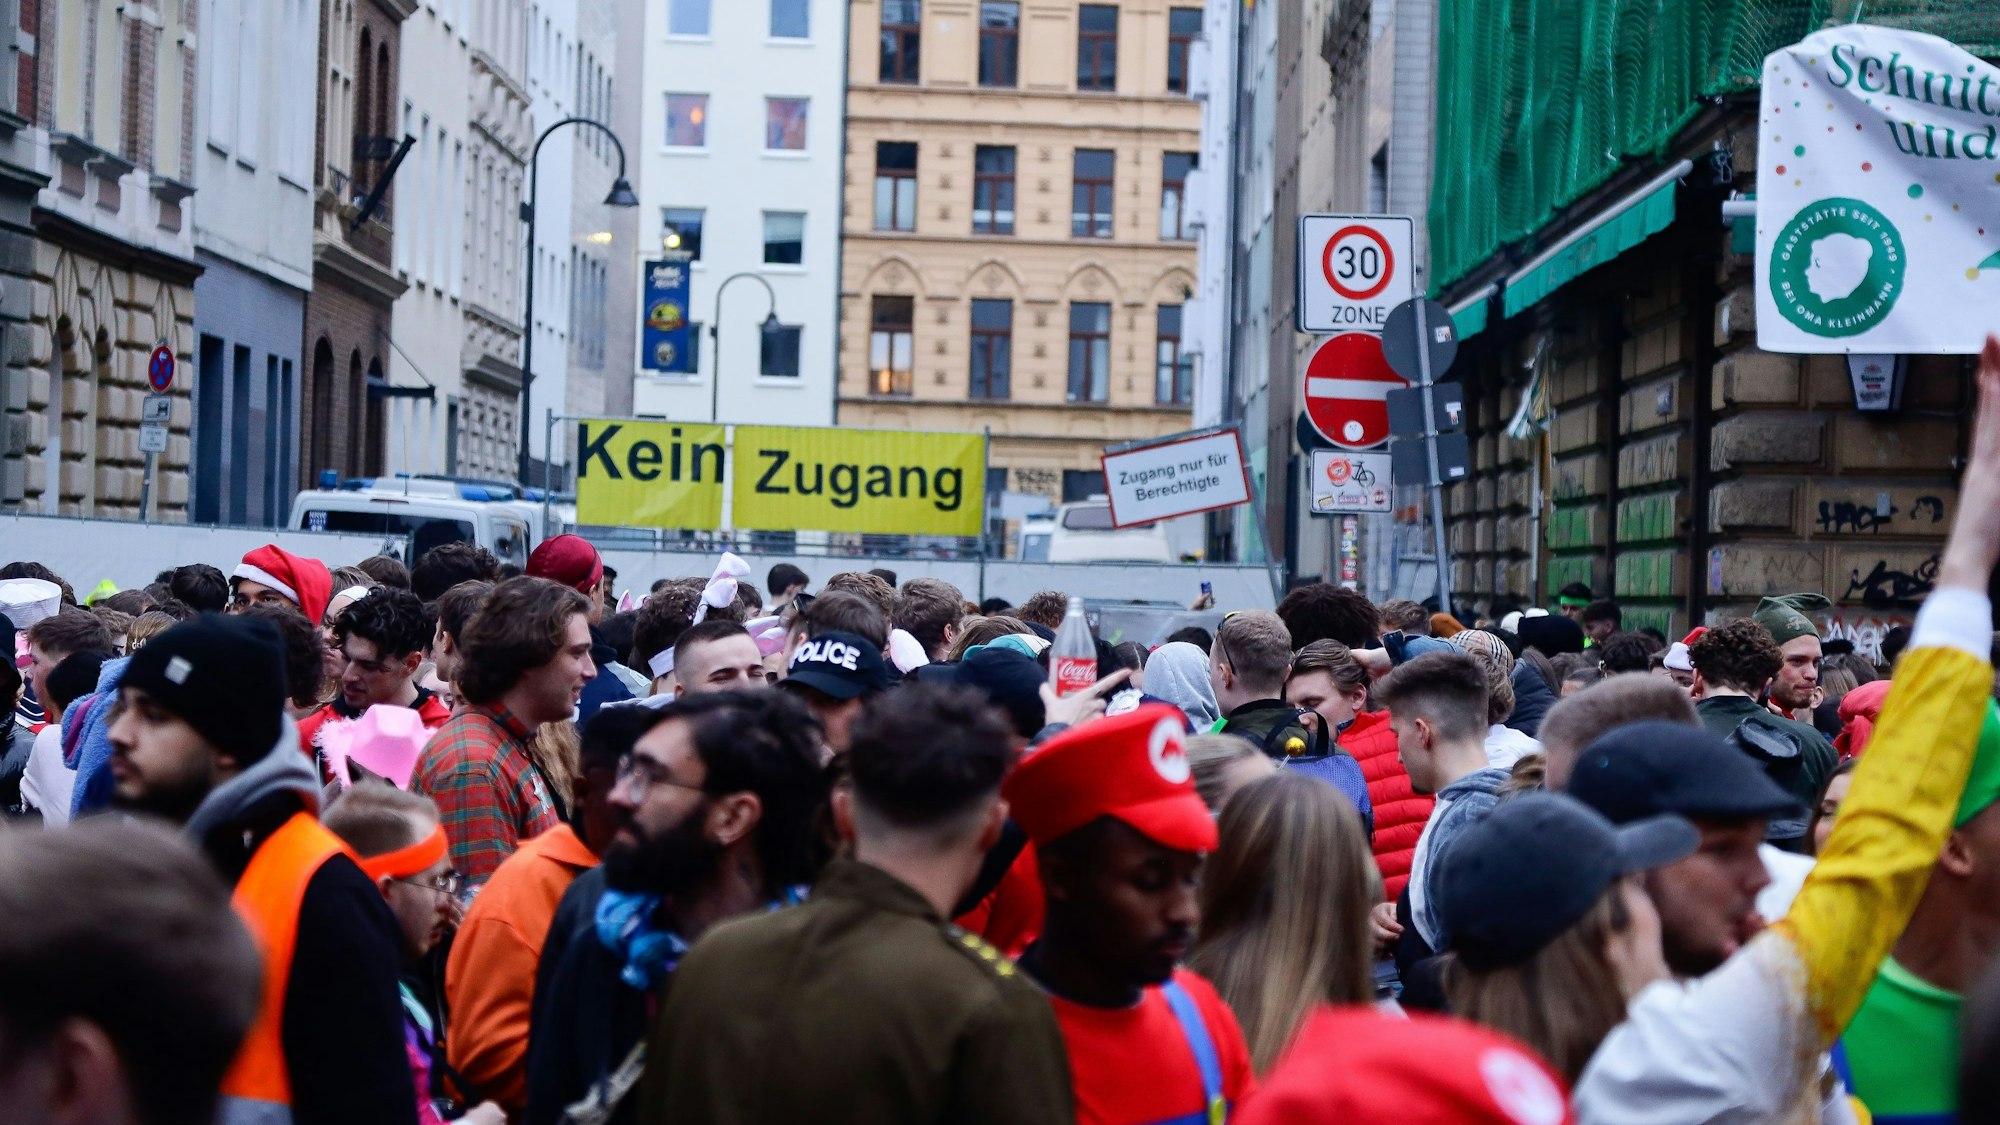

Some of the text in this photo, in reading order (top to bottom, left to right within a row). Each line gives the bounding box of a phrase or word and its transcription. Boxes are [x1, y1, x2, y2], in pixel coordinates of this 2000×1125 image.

[1827, 43, 2000, 117] Schnit
[1885, 123, 1998, 161] und
[1852, 208, 1880, 231] SEIT
[1880, 231, 1898, 262] 1949
[1338, 246, 1378, 279] 30
[1332, 305, 1387, 325] ZONE
[1781, 281, 1894, 329] BEI OMA KLEINMANN
[578, 423, 725, 483] Kein
[755, 449, 963, 513] Zugang
[1120, 453, 1229, 486] Zugang nur für
[1135, 475, 1220, 502] Berechtigte
